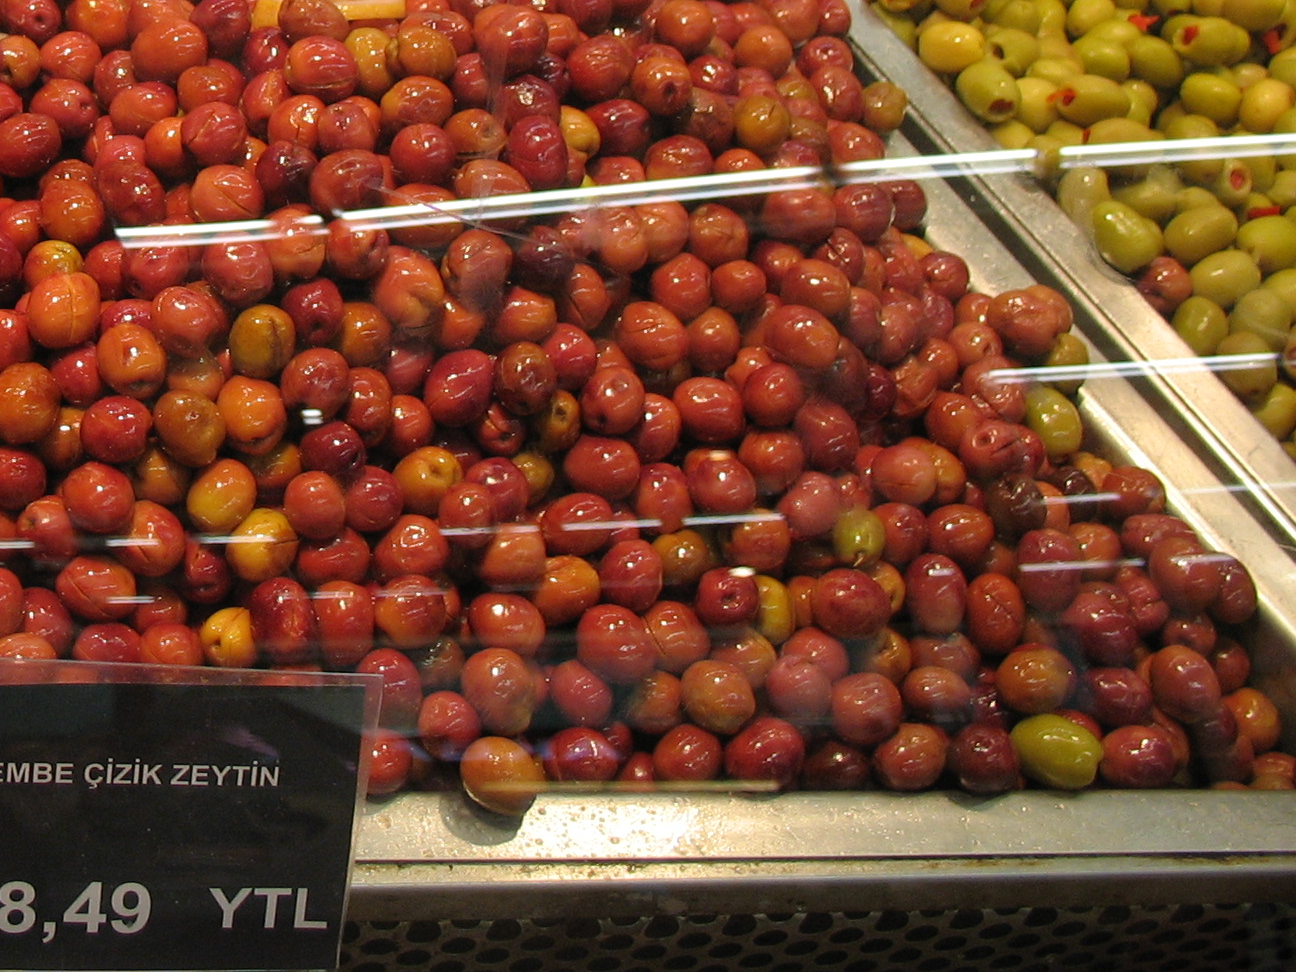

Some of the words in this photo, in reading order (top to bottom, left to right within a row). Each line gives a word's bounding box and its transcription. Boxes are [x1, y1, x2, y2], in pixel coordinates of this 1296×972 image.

[84, 758, 163, 789] ÇİZİK
[170, 760, 280, 787] ZEYTİN
[209, 887, 328, 929] YTL
